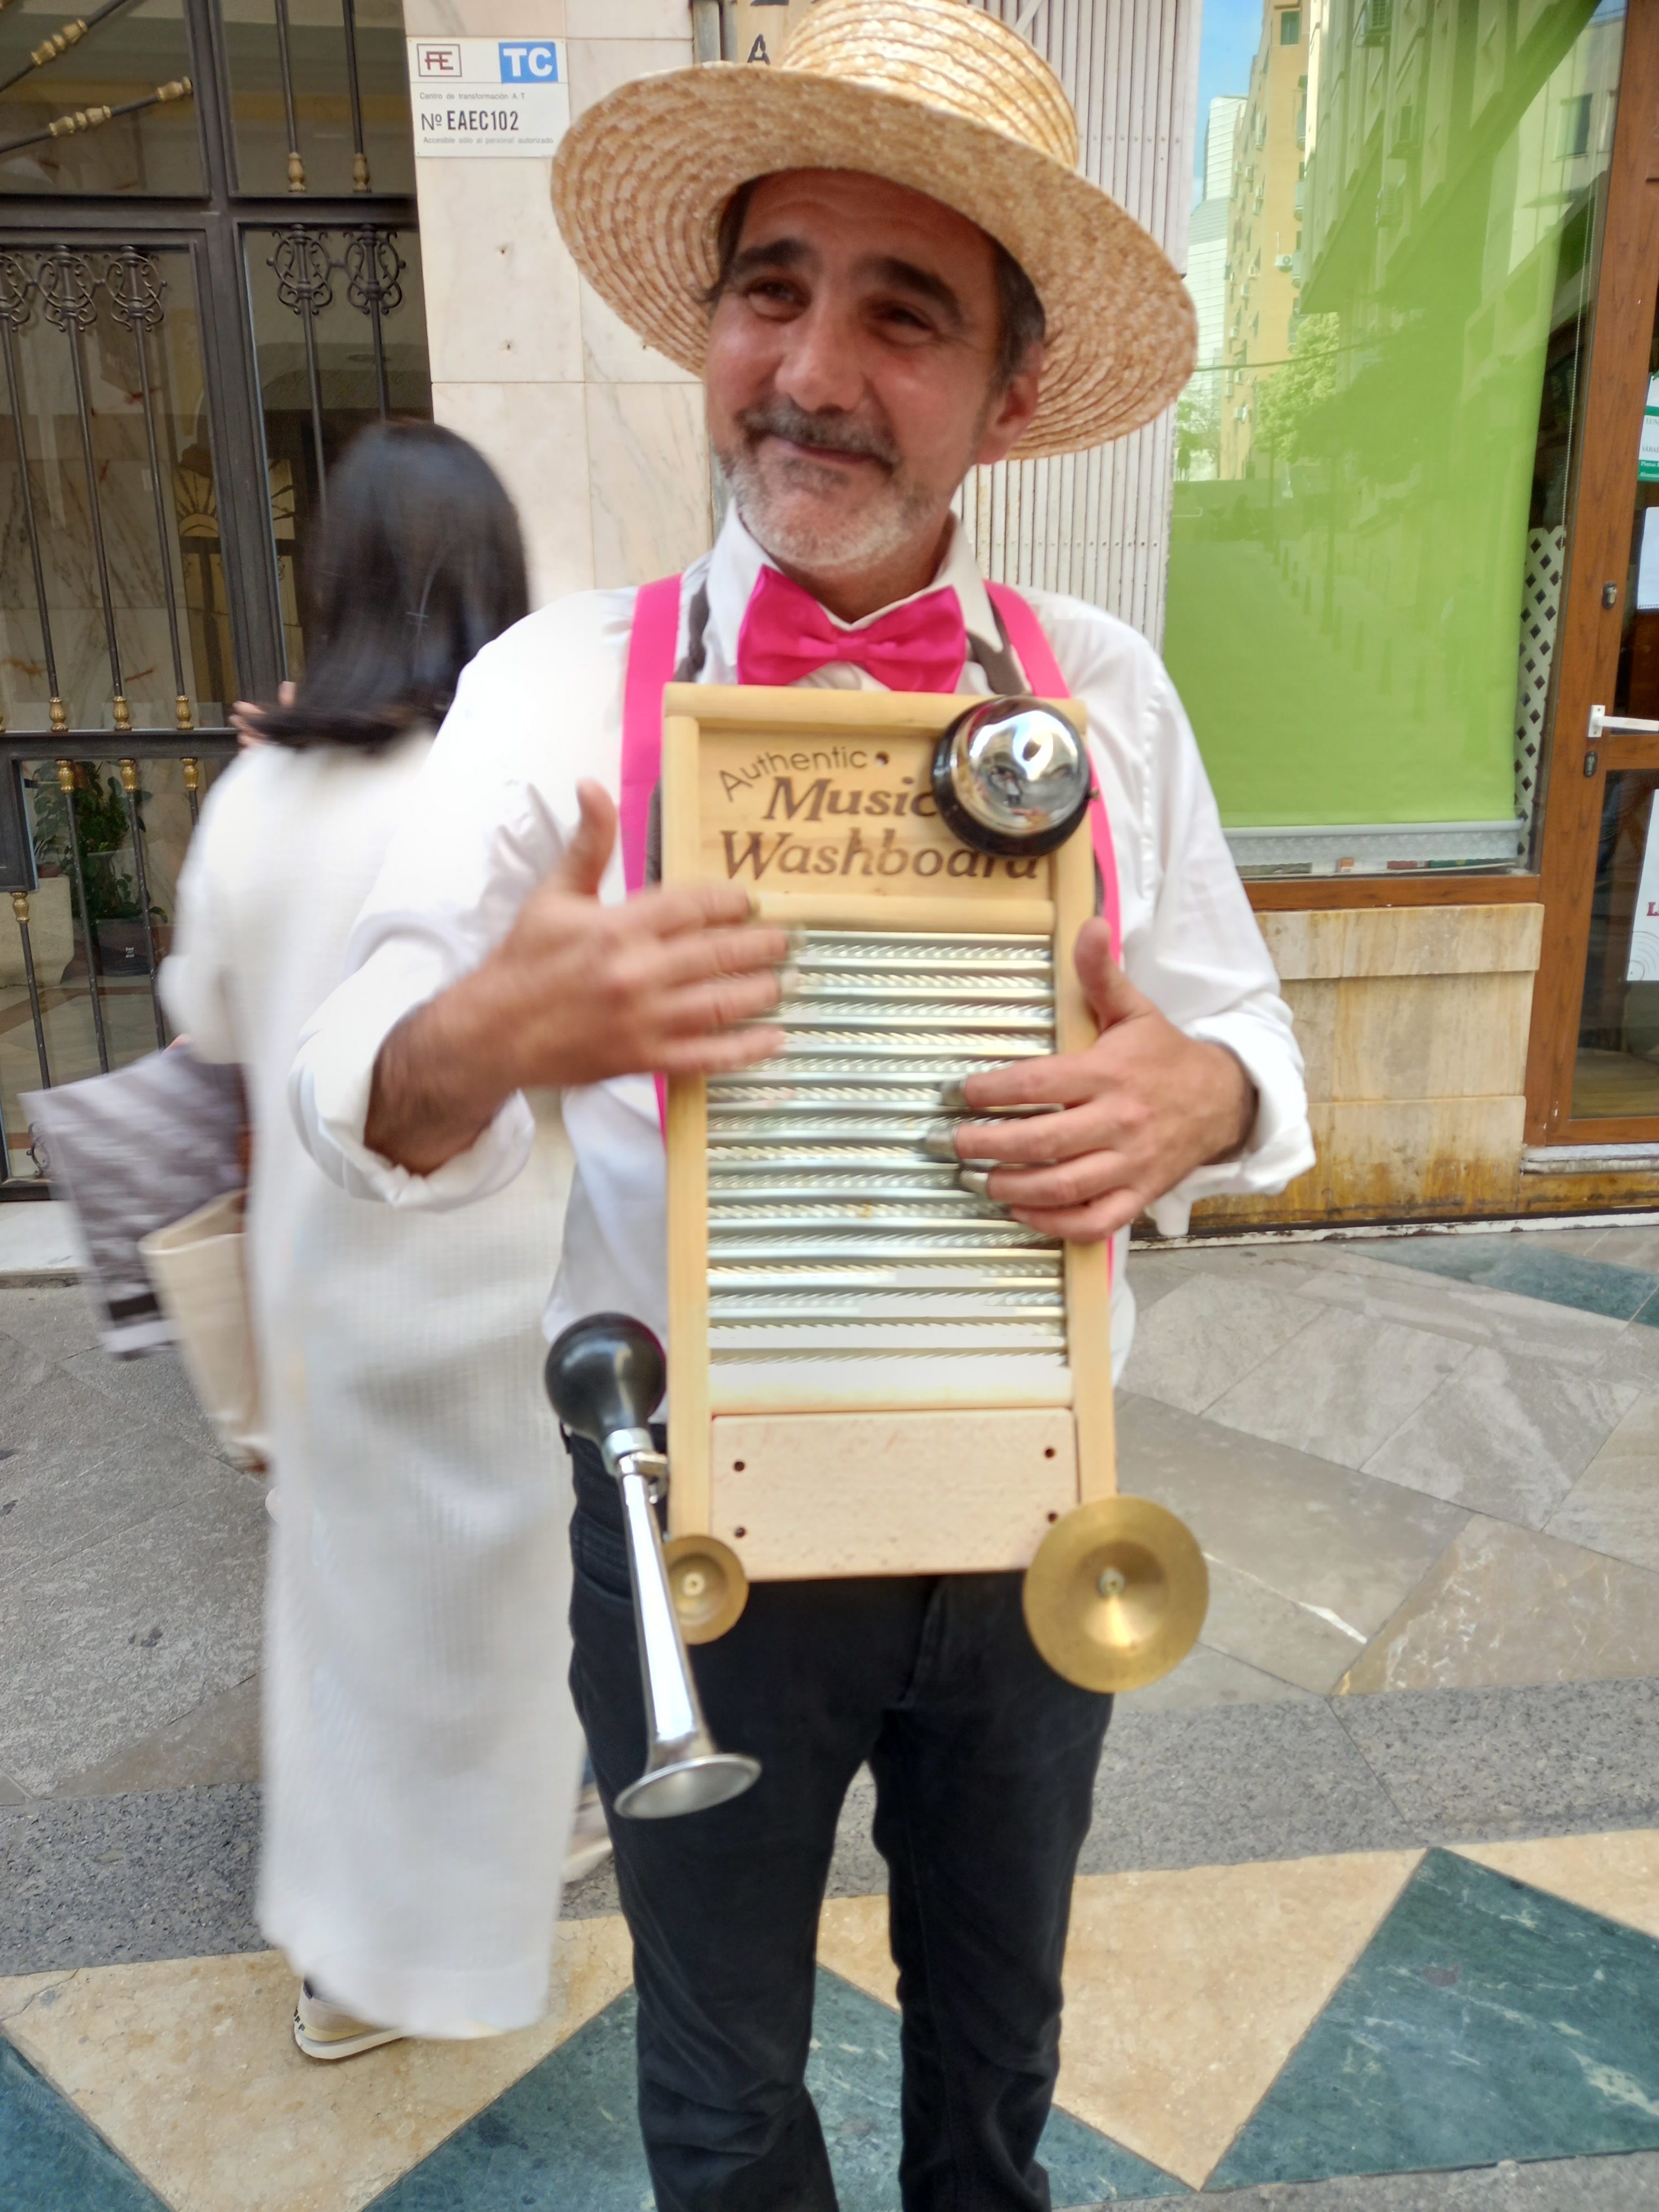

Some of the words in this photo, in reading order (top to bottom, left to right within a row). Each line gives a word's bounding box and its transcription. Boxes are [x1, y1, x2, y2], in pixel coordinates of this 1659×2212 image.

[503, 47, 553, 76] TC
[447, 110, 519, 131] EAEC102
[486, 137, 514, 145] personal
[719, 746, 867, 802] Authentic
[761, 775, 937, 822] Music
